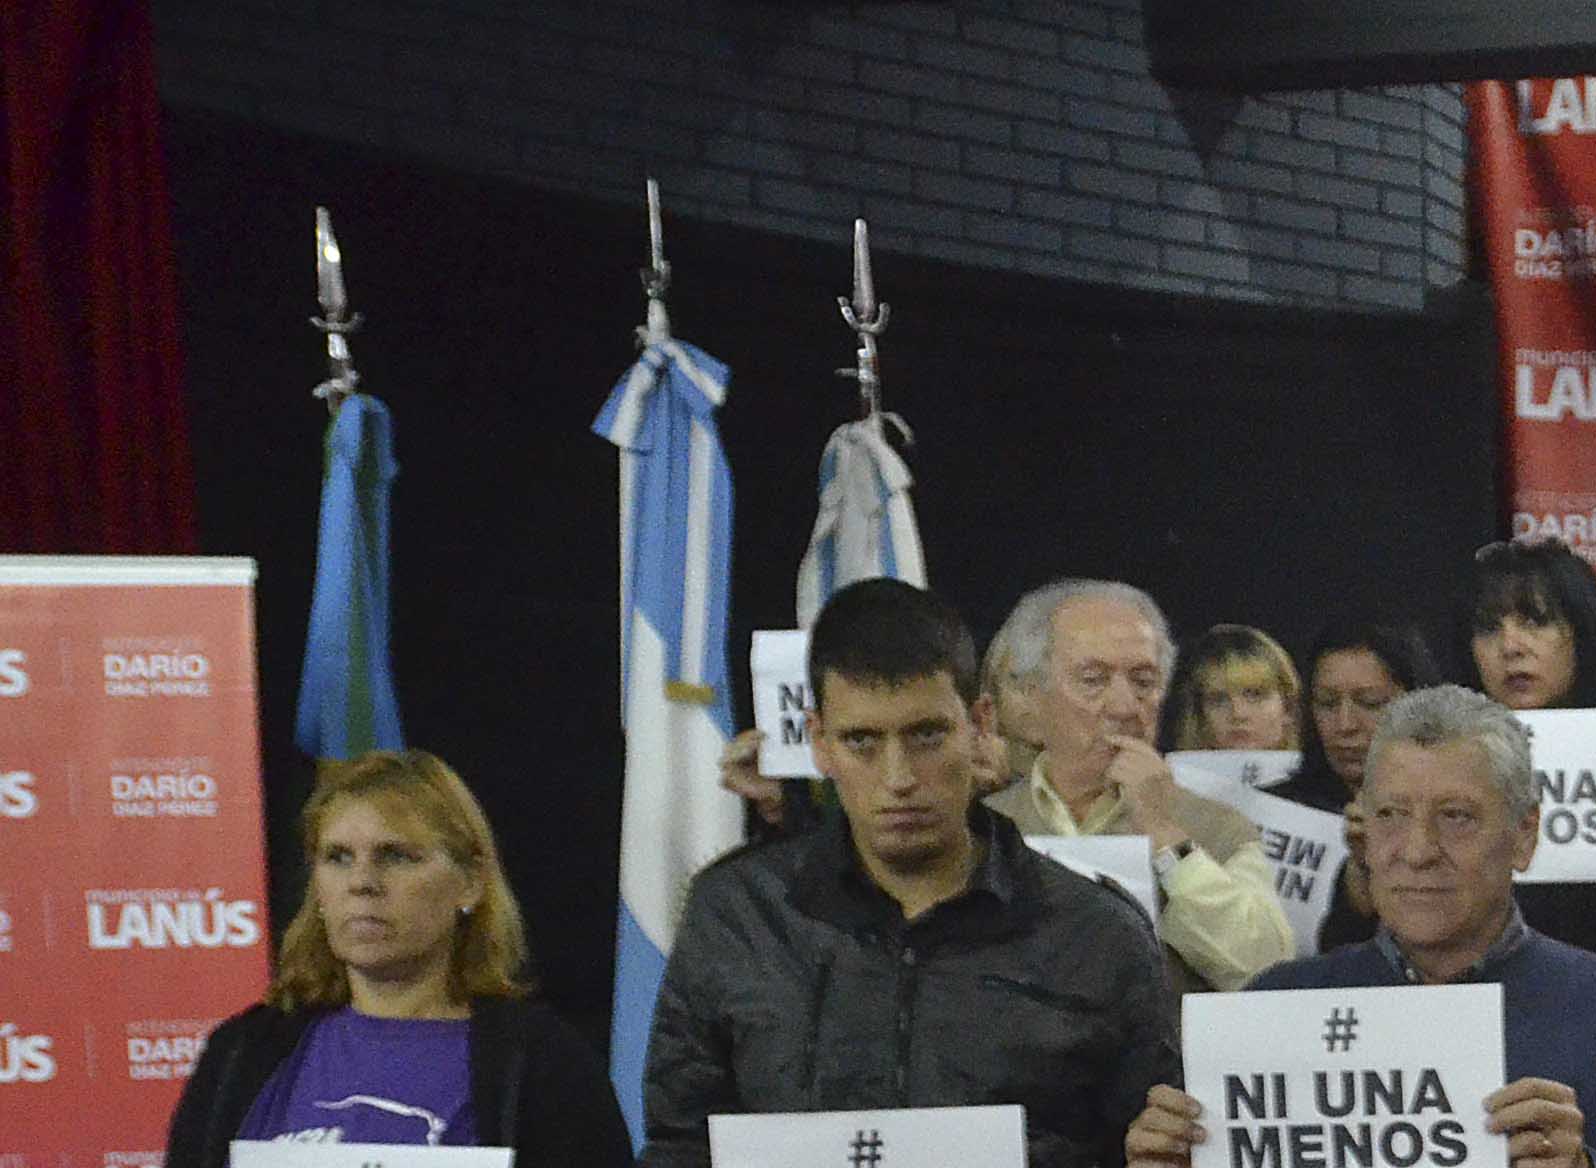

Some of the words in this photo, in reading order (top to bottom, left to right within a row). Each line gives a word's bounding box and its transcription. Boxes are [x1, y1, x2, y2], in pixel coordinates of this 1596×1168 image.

[104, 648, 208, 678] DARÍO
[112, 768, 218, 800] DARÍO
[87, 887, 260, 949] LANÚS
[1322, 1007, 1359, 1052] #
[1223, 1073, 1288, 1121] NI
[1312, 1068, 1454, 1119] UNA
